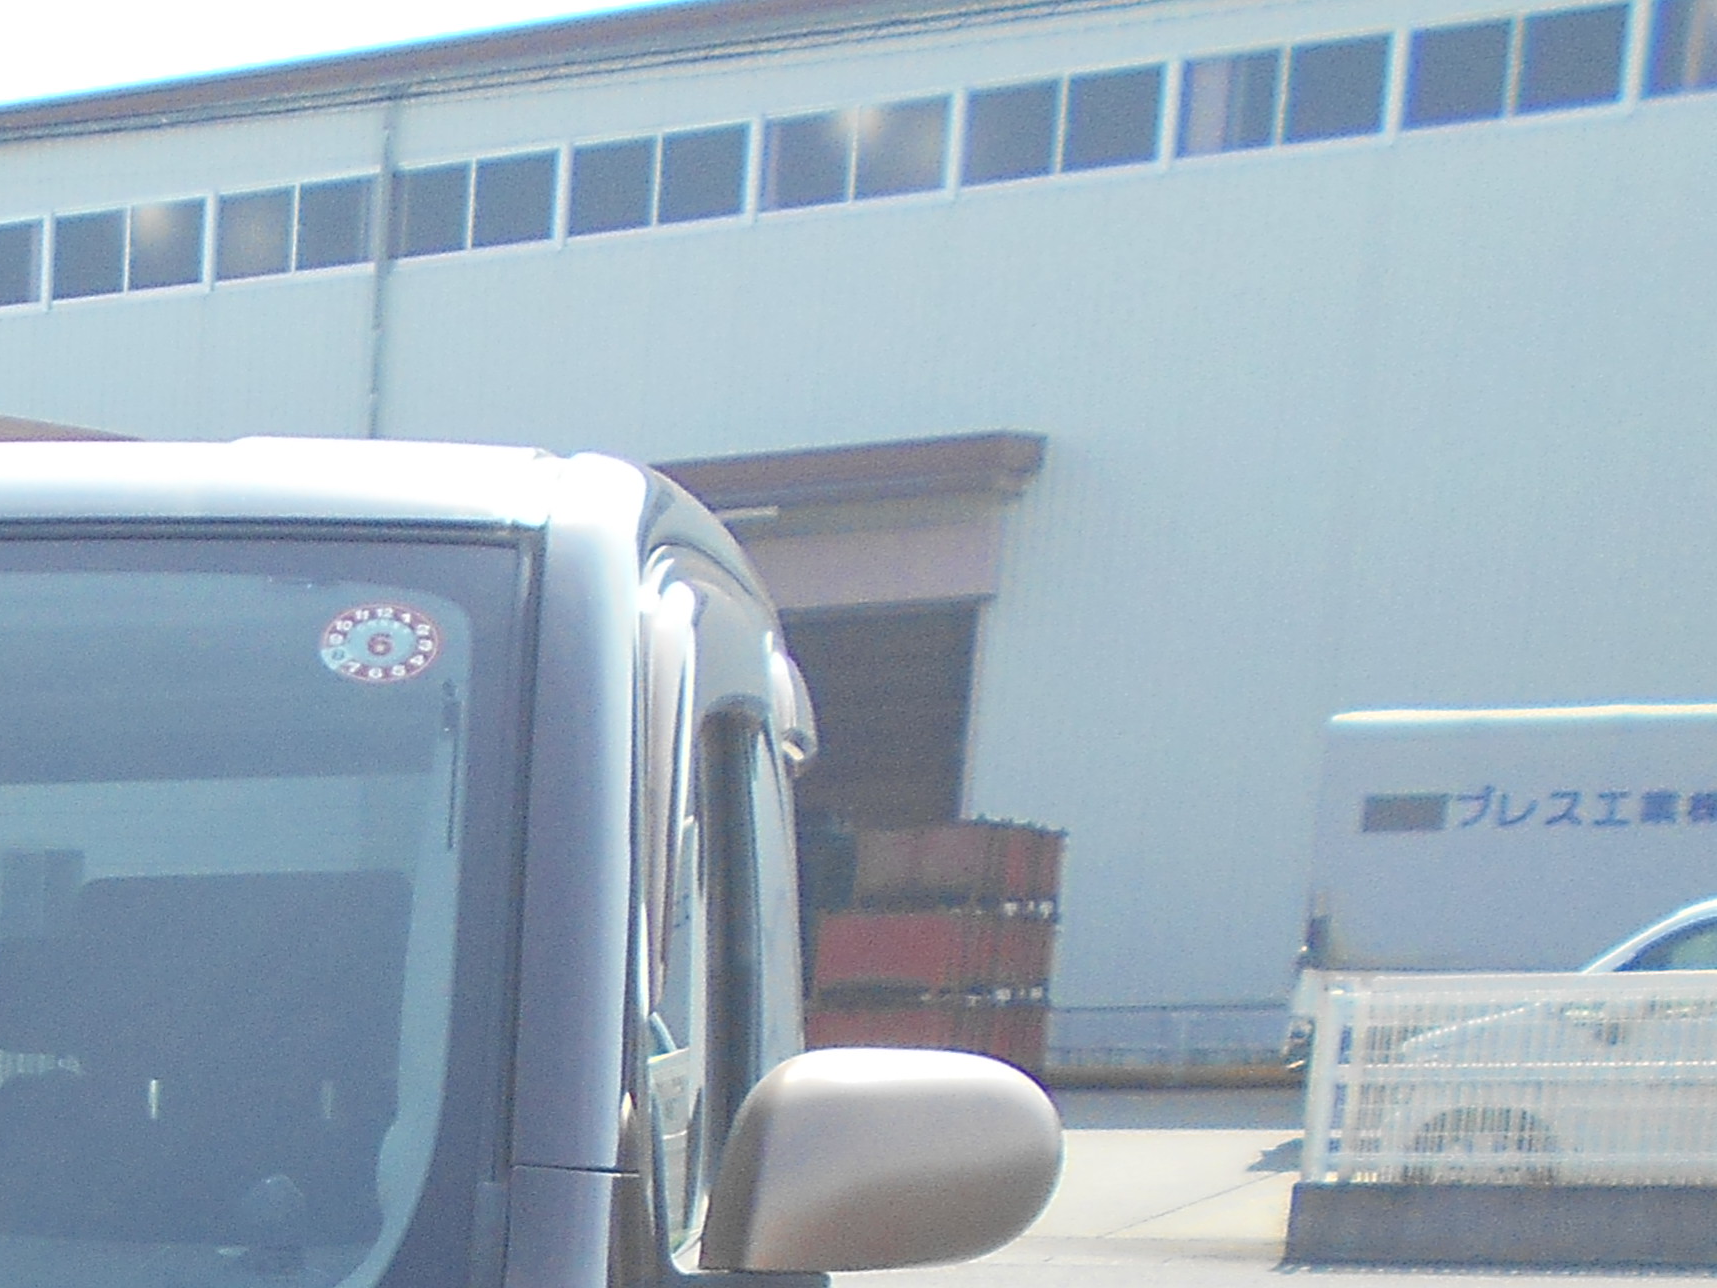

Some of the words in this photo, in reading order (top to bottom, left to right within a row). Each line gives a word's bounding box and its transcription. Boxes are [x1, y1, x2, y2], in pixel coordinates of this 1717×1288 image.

[355, 610, 369, 620] 11
[376, 608, 394, 619] 12
[402, 612, 412, 624] 1
[336, 620, 353, 632] 10
[416, 624, 431, 636] 2
[329, 633, 345, 645] 9
[418, 640, 433, 651] 3
[409, 654, 425, 667] 4
[348, 661, 361, 674] 7
[368, 667, 383, 680] 6
[392, 665, 406, 677] 5
